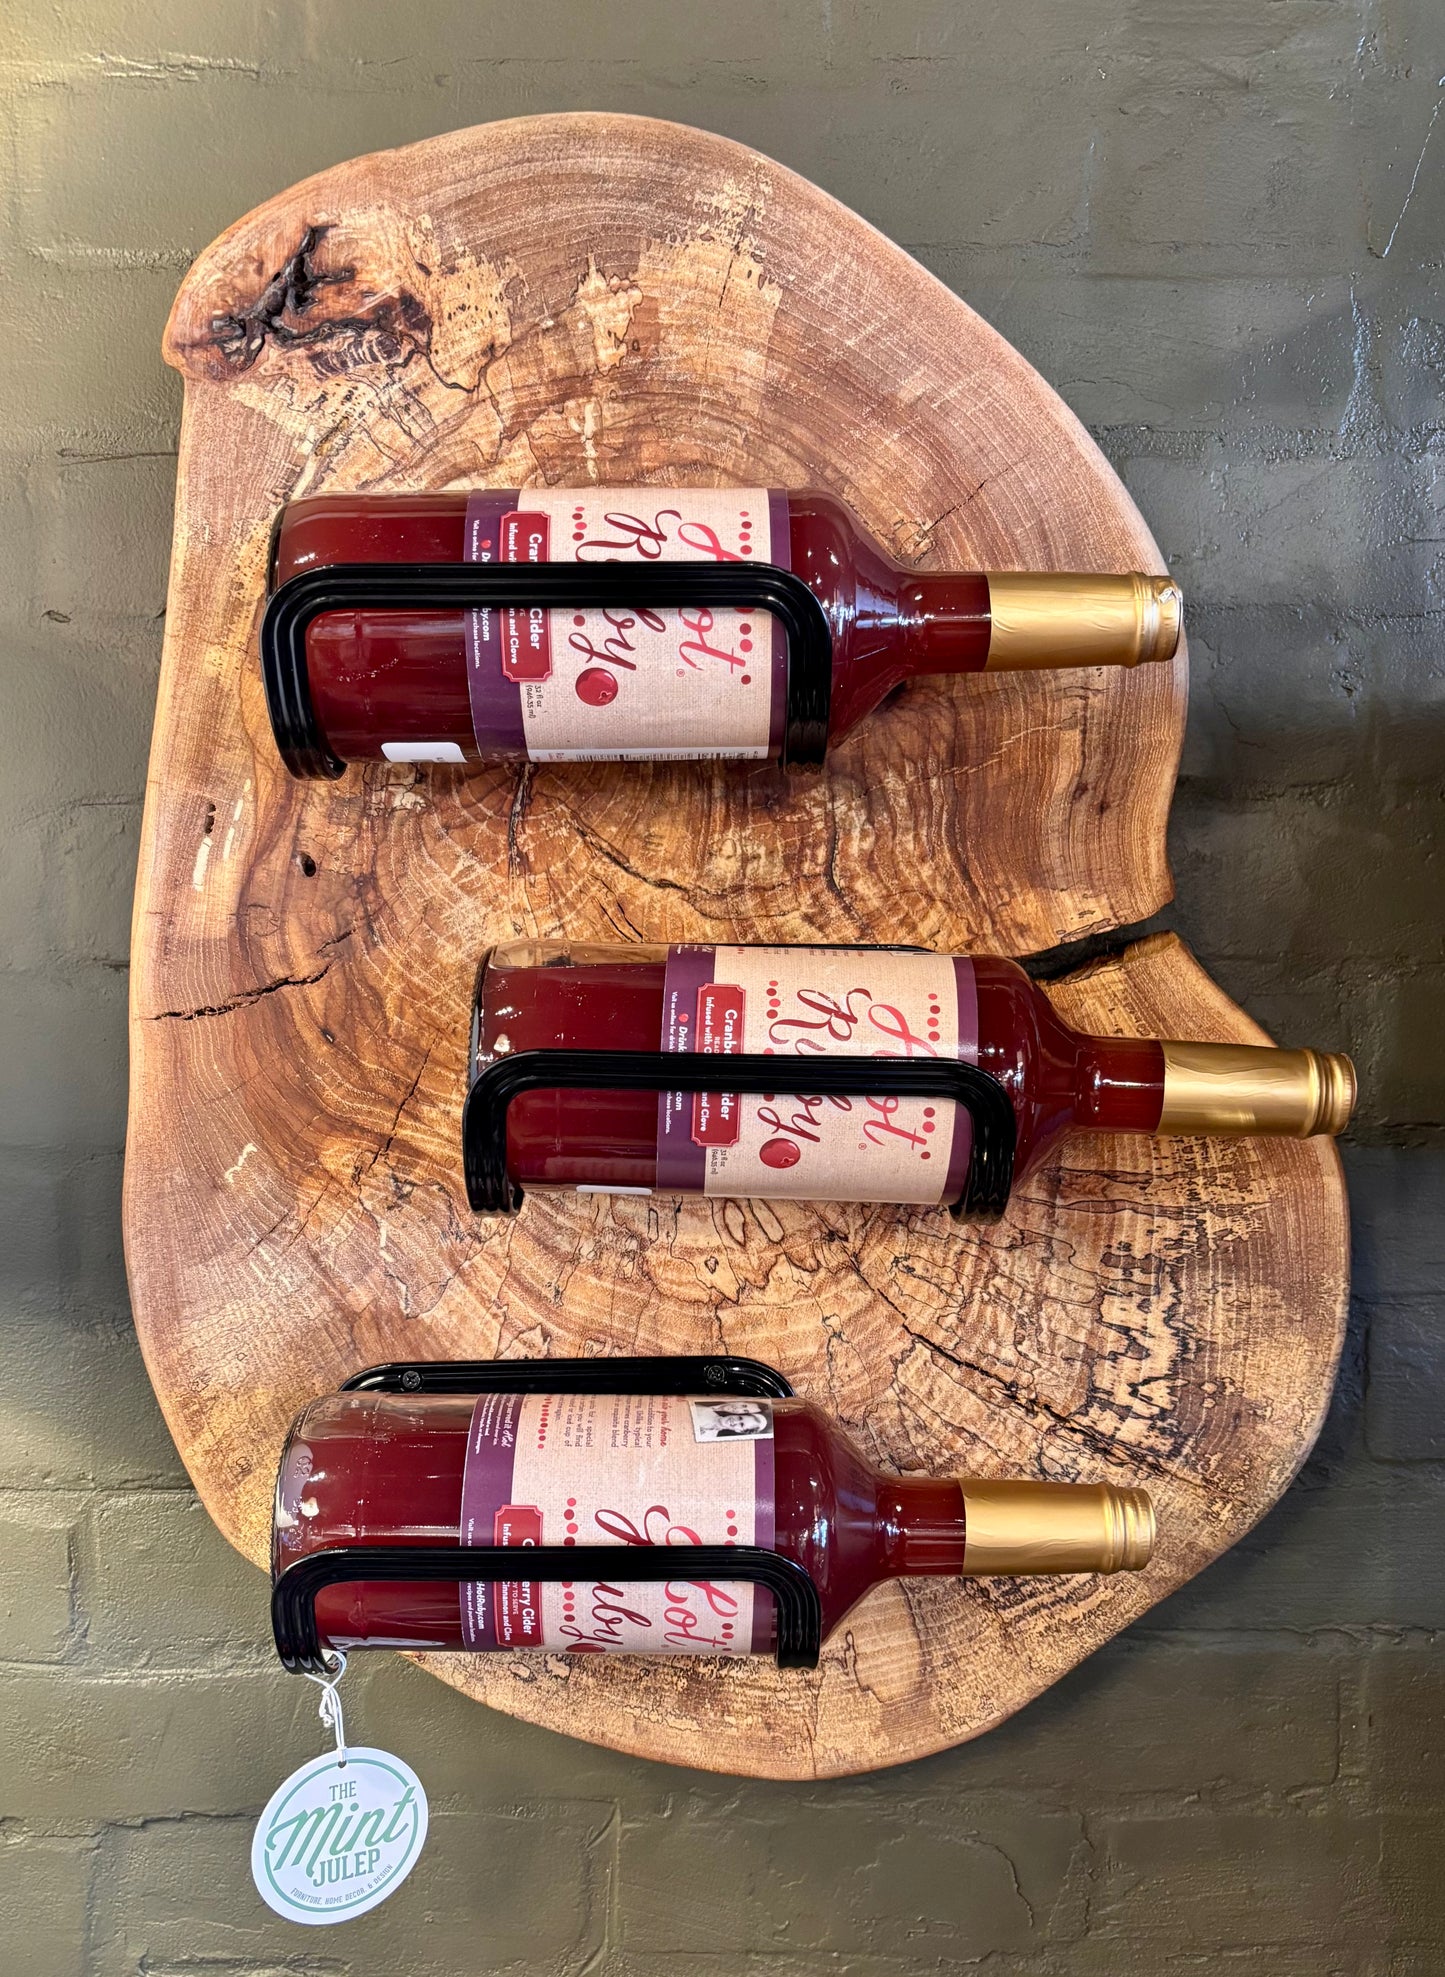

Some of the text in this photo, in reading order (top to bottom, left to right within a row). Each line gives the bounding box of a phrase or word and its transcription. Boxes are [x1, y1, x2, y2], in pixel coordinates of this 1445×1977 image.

[472, 519, 480, 530] Visit
[508, 522, 518, 550] Infused
[471, 552, 479, 561] for
[569, 510, 682, 670] Rby
[509, 618, 518, 636] and
[529, 608, 543, 649] Cider
[473, 640, 481, 669] locations.
[510, 637, 519, 664] Clove
[534, 685, 542, 695] 32
[705, 996, 715, 1025] Infused
[703, 1026, 713, 1045] with
[713, 1036, 721, 1054] READ
[701, 1092, 710, 1107] and
[720, 1093, 734, 1120] ider
[700, 1108, 709, 1132] Clove
[566, 1413, 575, 1425] iced
[576, 1423, 584, 1433] will
[501, 1429, 514, 1448] Hot
[563, 1426, 571, 1438] cup
[574, 1434, 583, 1447] find
[585, 1426, 594, 1448] special
[611, 1429, 620, 1448] blend
[621, 1419, 631, 1448] cranberry
[633, 1427, 642, 1448] typical
[644, 1433, 652, 1448] your
[659, 1426, 672, 1447] home
[564, 1439, 573, 1447] of
[467, 1518, 475, 1532] Visit
[502, 1523, 512, 1546] Infus
[467, 1532, 473, 1540] us
[512, 1589, 518, 1598] TO
[503, 1615, 512, 1626] and
[522, 1608, 536, 1635] Cider
[504, 1627, 512, 1641] Clove
[329, 1780, 357, 1802] THE
[265, 1786, 416, 1878] Mint
[312, 1848, 381, 1888] JULEP
[325, 1895, 343, 1905] HOME
[373, 1864, 394, 1885] DESIGN
